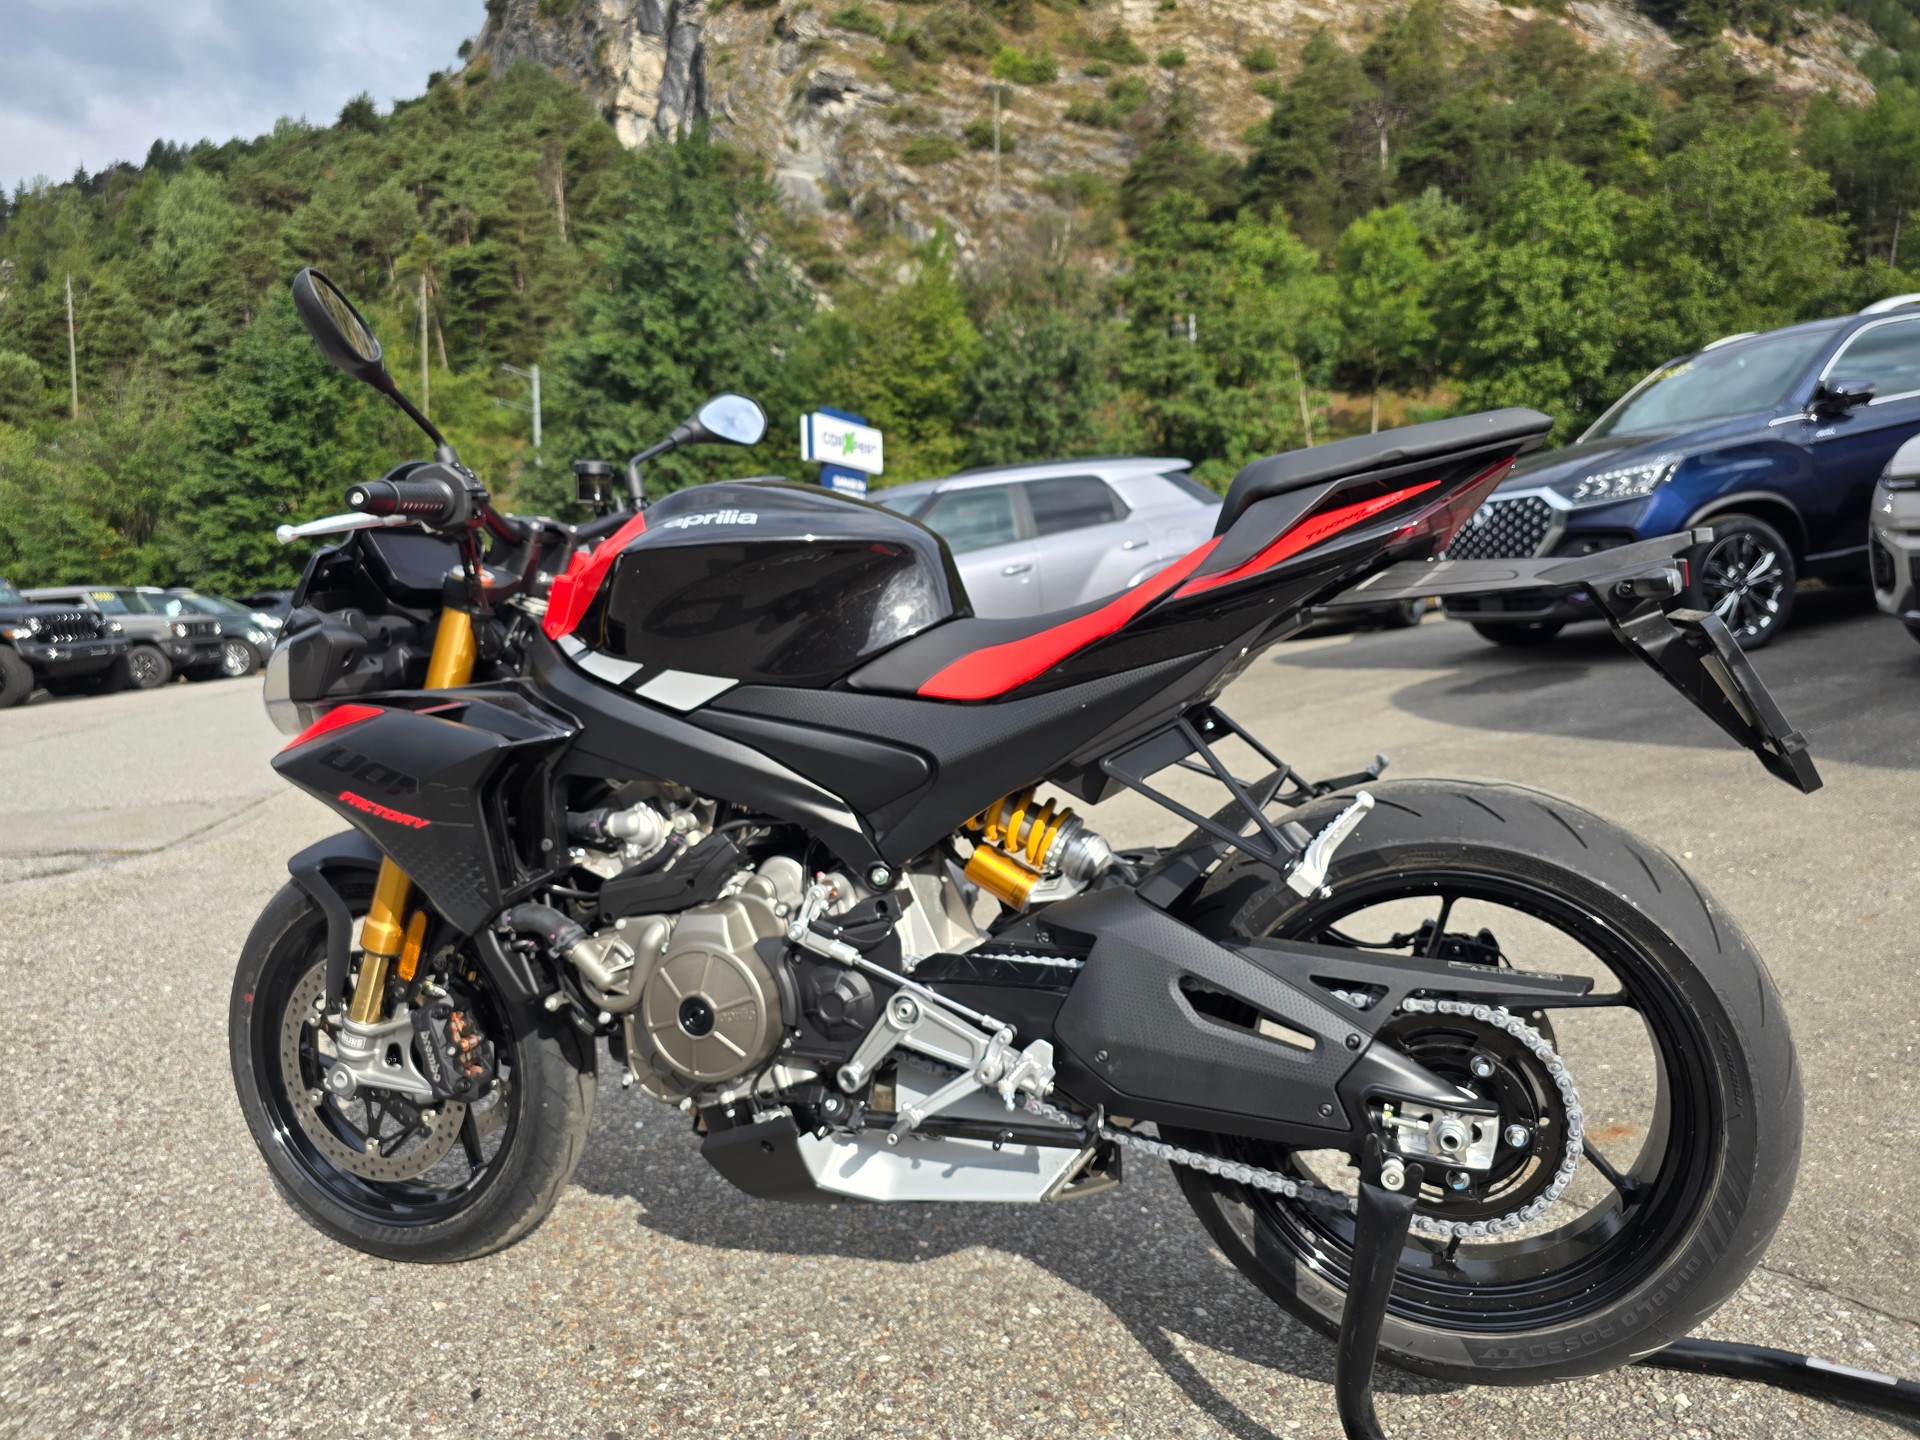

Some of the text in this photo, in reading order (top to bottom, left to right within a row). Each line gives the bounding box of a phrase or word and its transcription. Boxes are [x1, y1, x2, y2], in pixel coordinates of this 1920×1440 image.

[663, 509, 758, 528] aprilia
[338, 790, 431, 829] FACTORY
[420, 1030, 441, 1082] brembo
[1621, 1257, 1702, 1328] DIABLO
[1529, 1325, 1614, 1357] ROSSO
